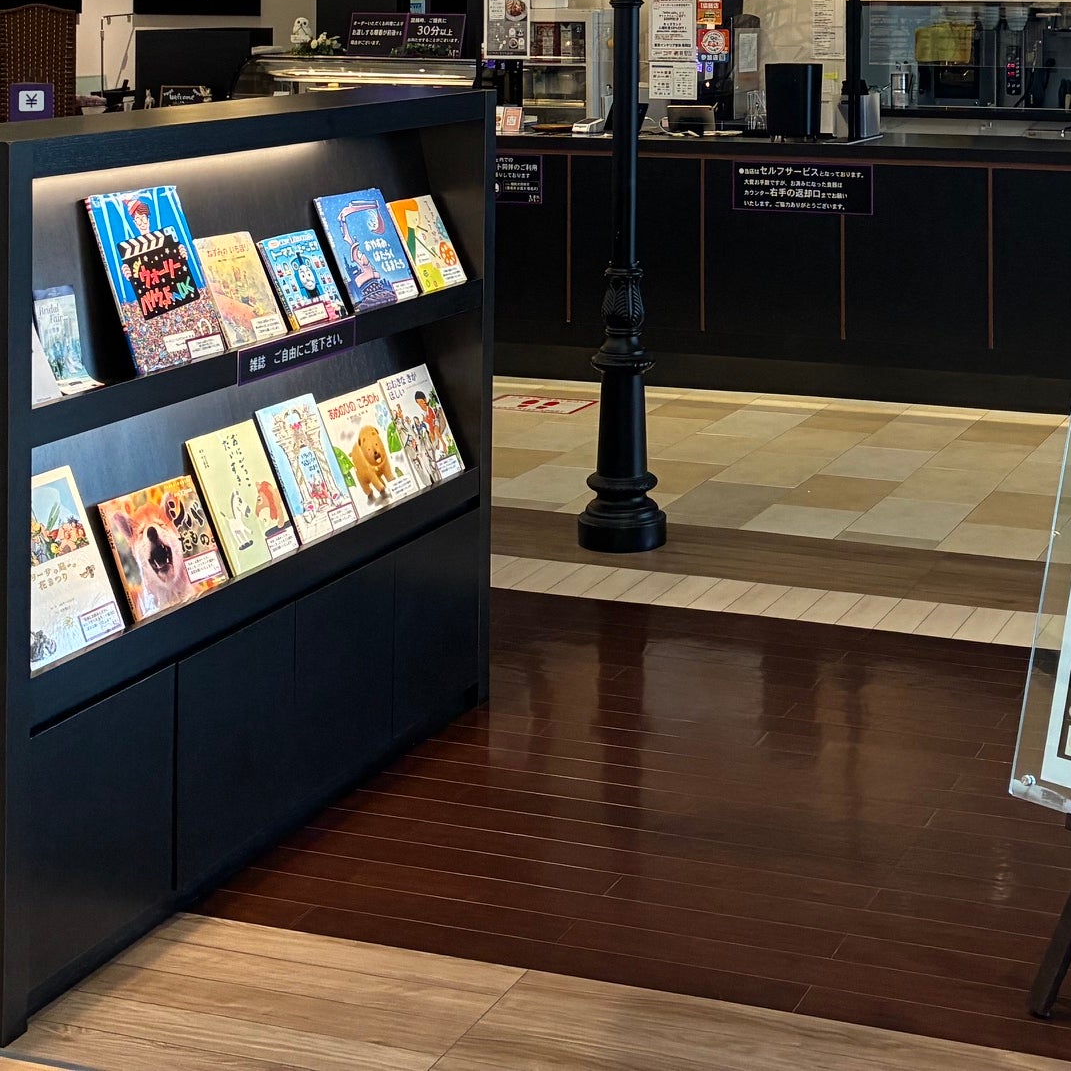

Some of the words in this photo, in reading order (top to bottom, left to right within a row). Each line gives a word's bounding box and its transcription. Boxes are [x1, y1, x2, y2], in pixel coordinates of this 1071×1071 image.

[250, 355, 266, 372] 雑誌
[274, 334, 343, 364] ご自由にご覧下さい。
